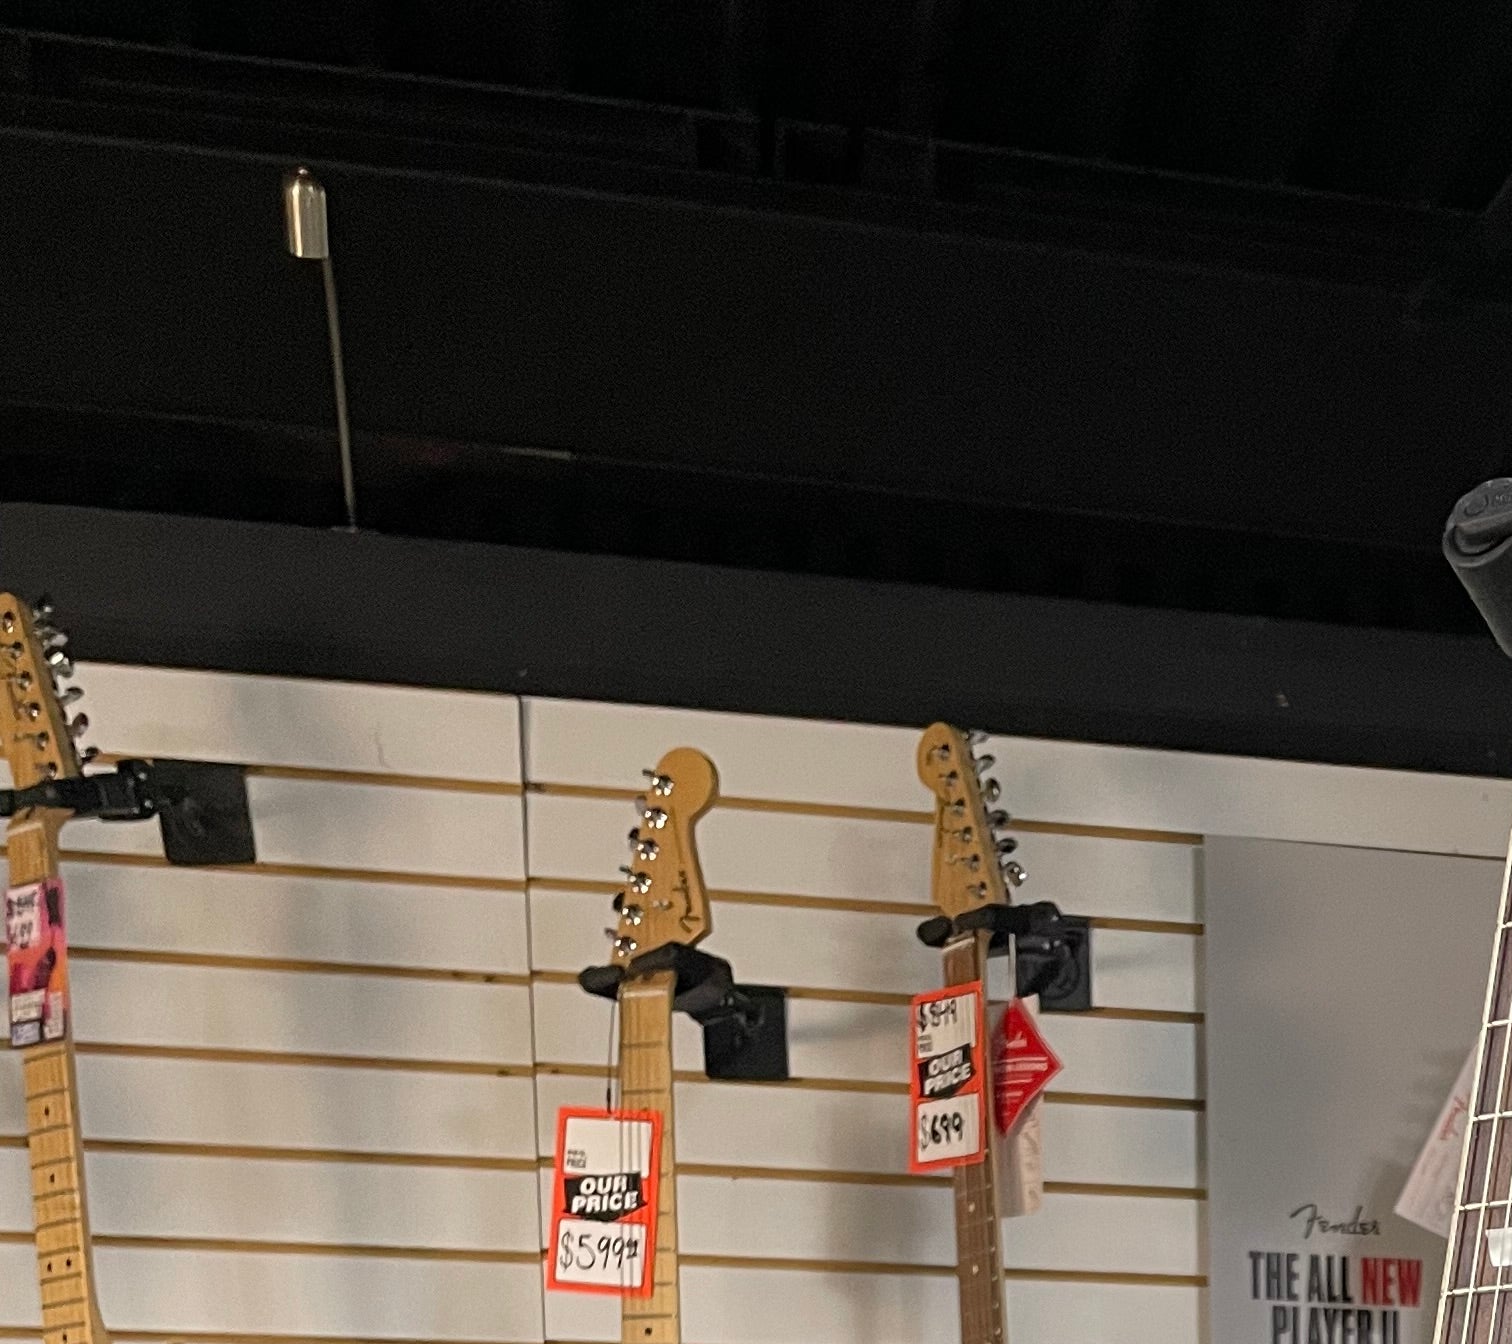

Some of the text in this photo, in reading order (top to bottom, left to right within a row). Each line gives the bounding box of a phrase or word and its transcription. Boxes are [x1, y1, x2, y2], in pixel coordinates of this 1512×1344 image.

[923, 1062, 972, 1097] PRICE
[928, 1050, 964, 1077] OUR
[920, 1112, 964, 1150] $699
[571, 1190, 639, 1214] PRICE
[579, 1174, 628, 1195] OUR
[1289, 1203, 1381, 1240] Fender
[1248, 1250, 1423, 1308] THE ALL NEW
